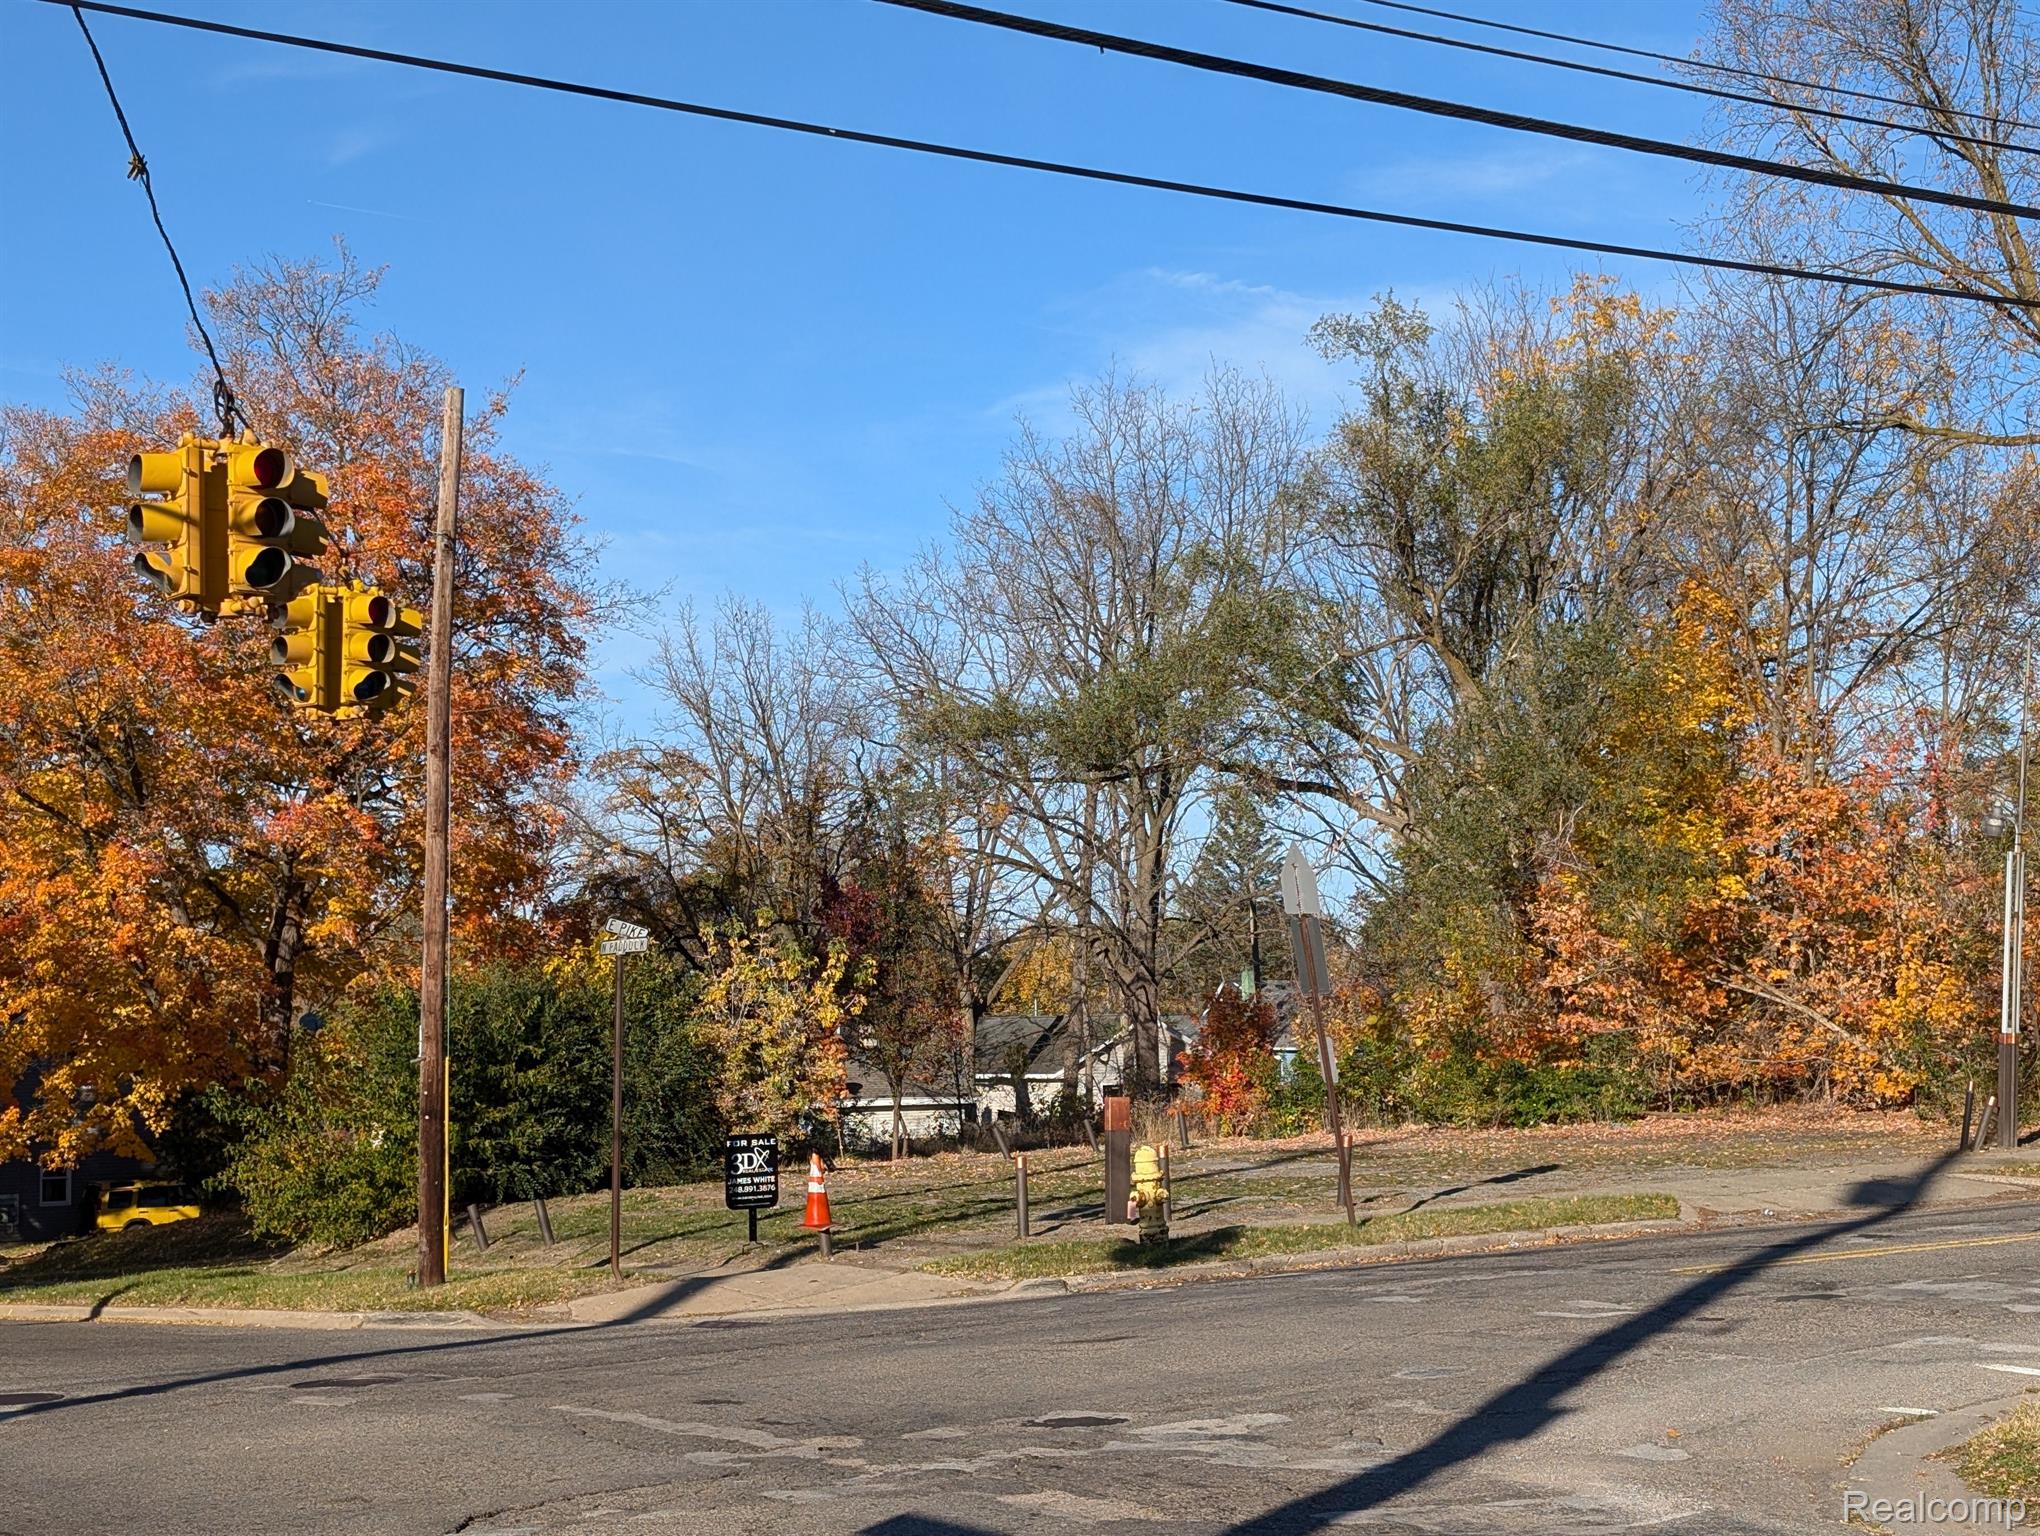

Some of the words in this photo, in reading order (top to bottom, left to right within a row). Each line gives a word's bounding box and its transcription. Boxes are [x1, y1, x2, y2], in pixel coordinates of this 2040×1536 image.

[609, 920, 616, 931] E
[619, 922, 645, 938] PIKE
[751, 1138, 776, 1147] SALE
[727, 1177, 751, 1185] JAMES
[728, 1184, 776, 1194] 248.891.3876
